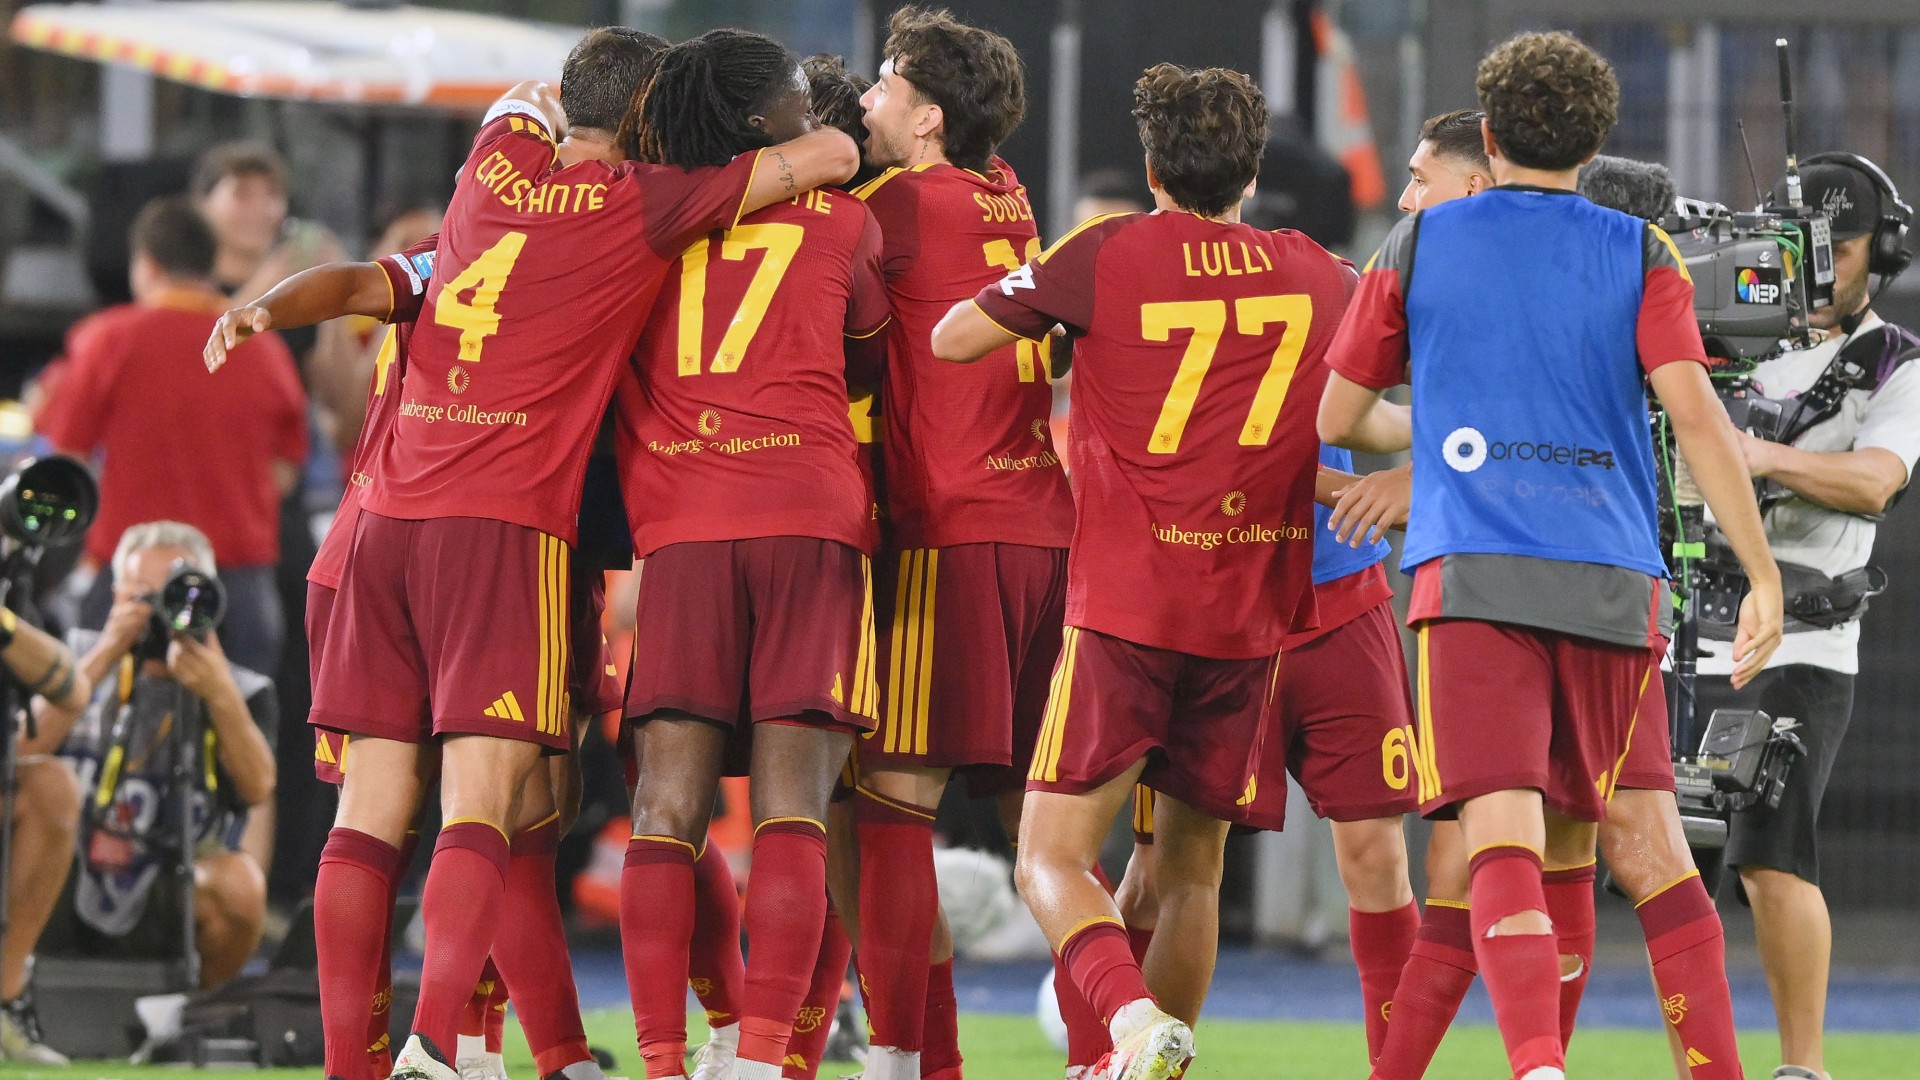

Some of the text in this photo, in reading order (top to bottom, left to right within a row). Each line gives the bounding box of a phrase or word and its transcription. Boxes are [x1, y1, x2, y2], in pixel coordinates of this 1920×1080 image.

[1182, 241, 1273, 277] LULLI
[434, 231, 528, 362] 4
[677, 222, 805, 377] 17
[1749, 283, 1779, 304] NEP
[1140, 294, 1313, 455] 77
[447, 403, 528, 427] Collection
[1150, 520, 1309, 551] Auberge Collecion
